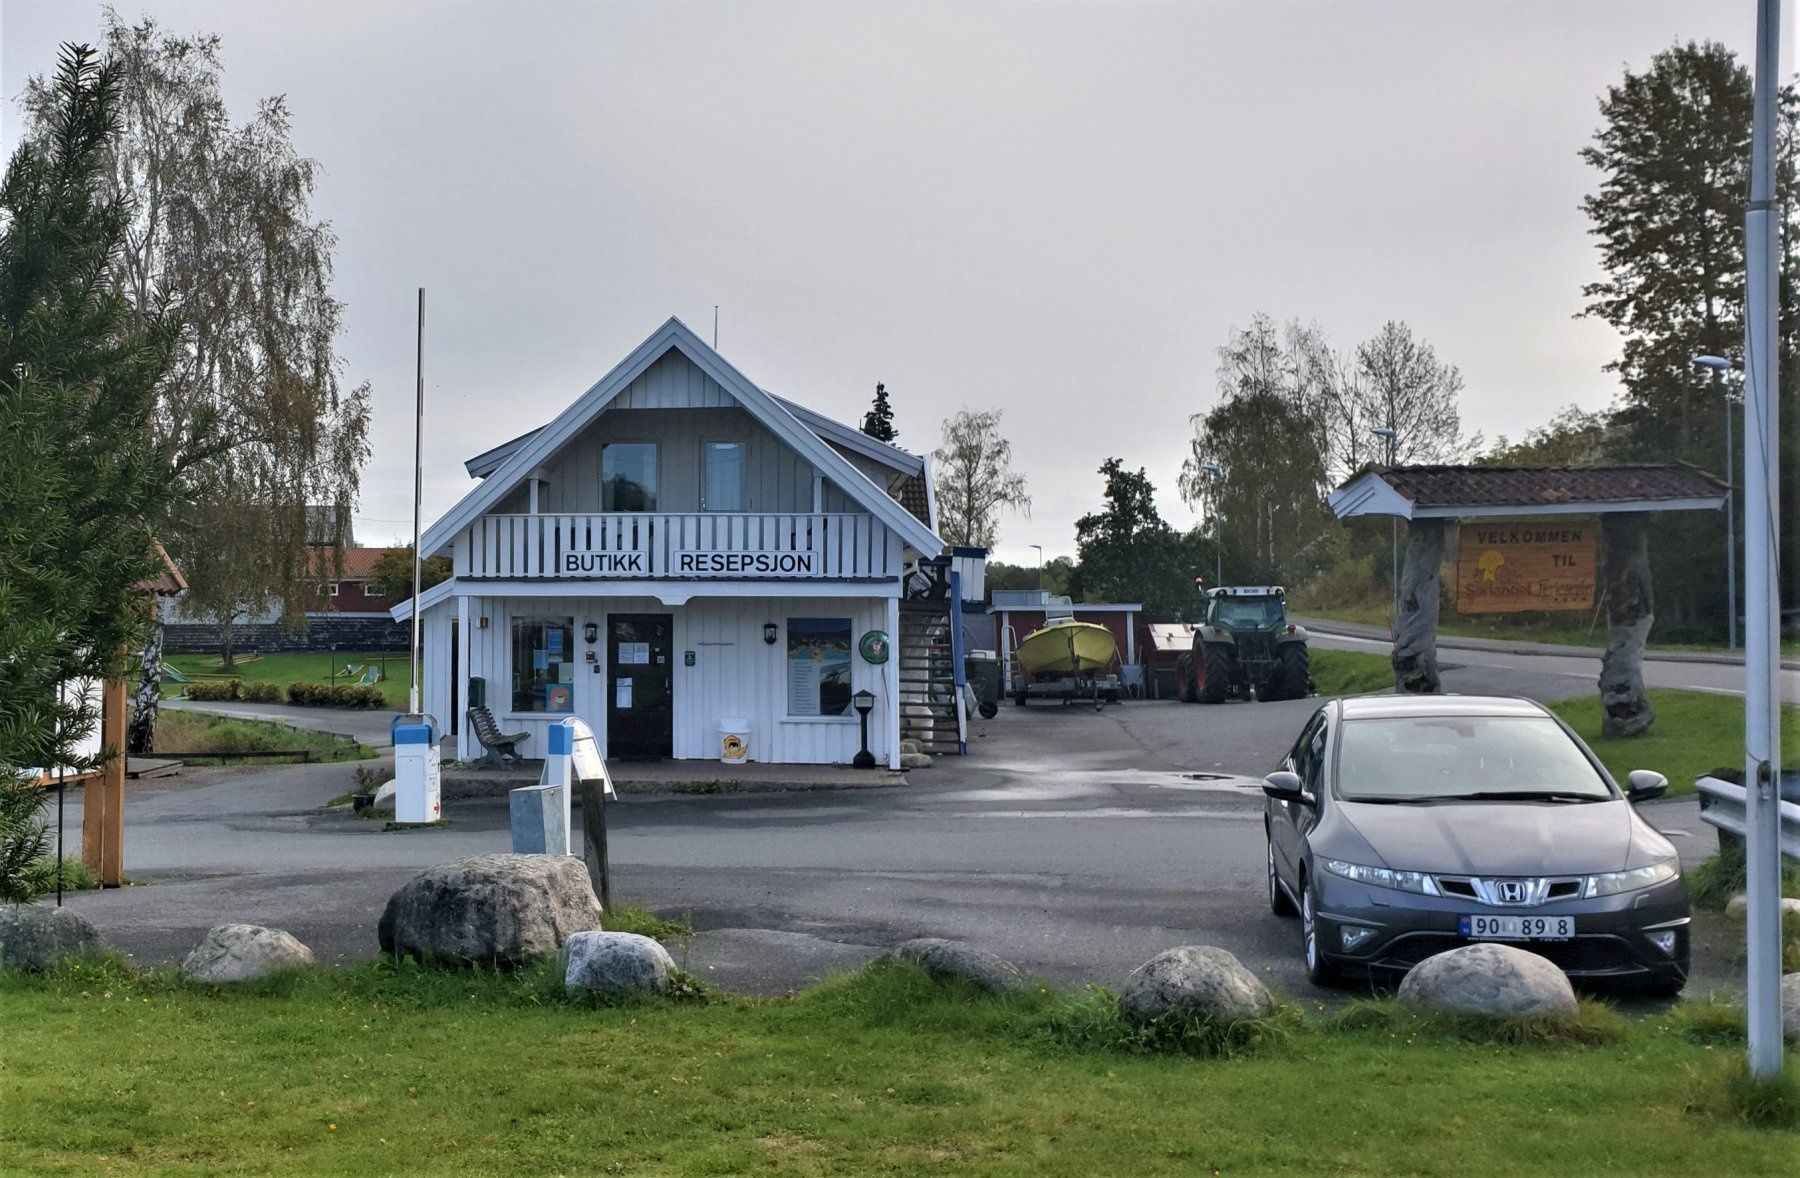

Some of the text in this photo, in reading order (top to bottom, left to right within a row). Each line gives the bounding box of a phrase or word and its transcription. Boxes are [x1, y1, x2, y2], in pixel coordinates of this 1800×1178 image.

[1477, 530, 1583, 544] VELKOMMEN
[566, 554, 642, 571] BUTIKK
[680, 554, 811, 572] RESEPSJON
[1551, 554, 1577, 567] TIL
